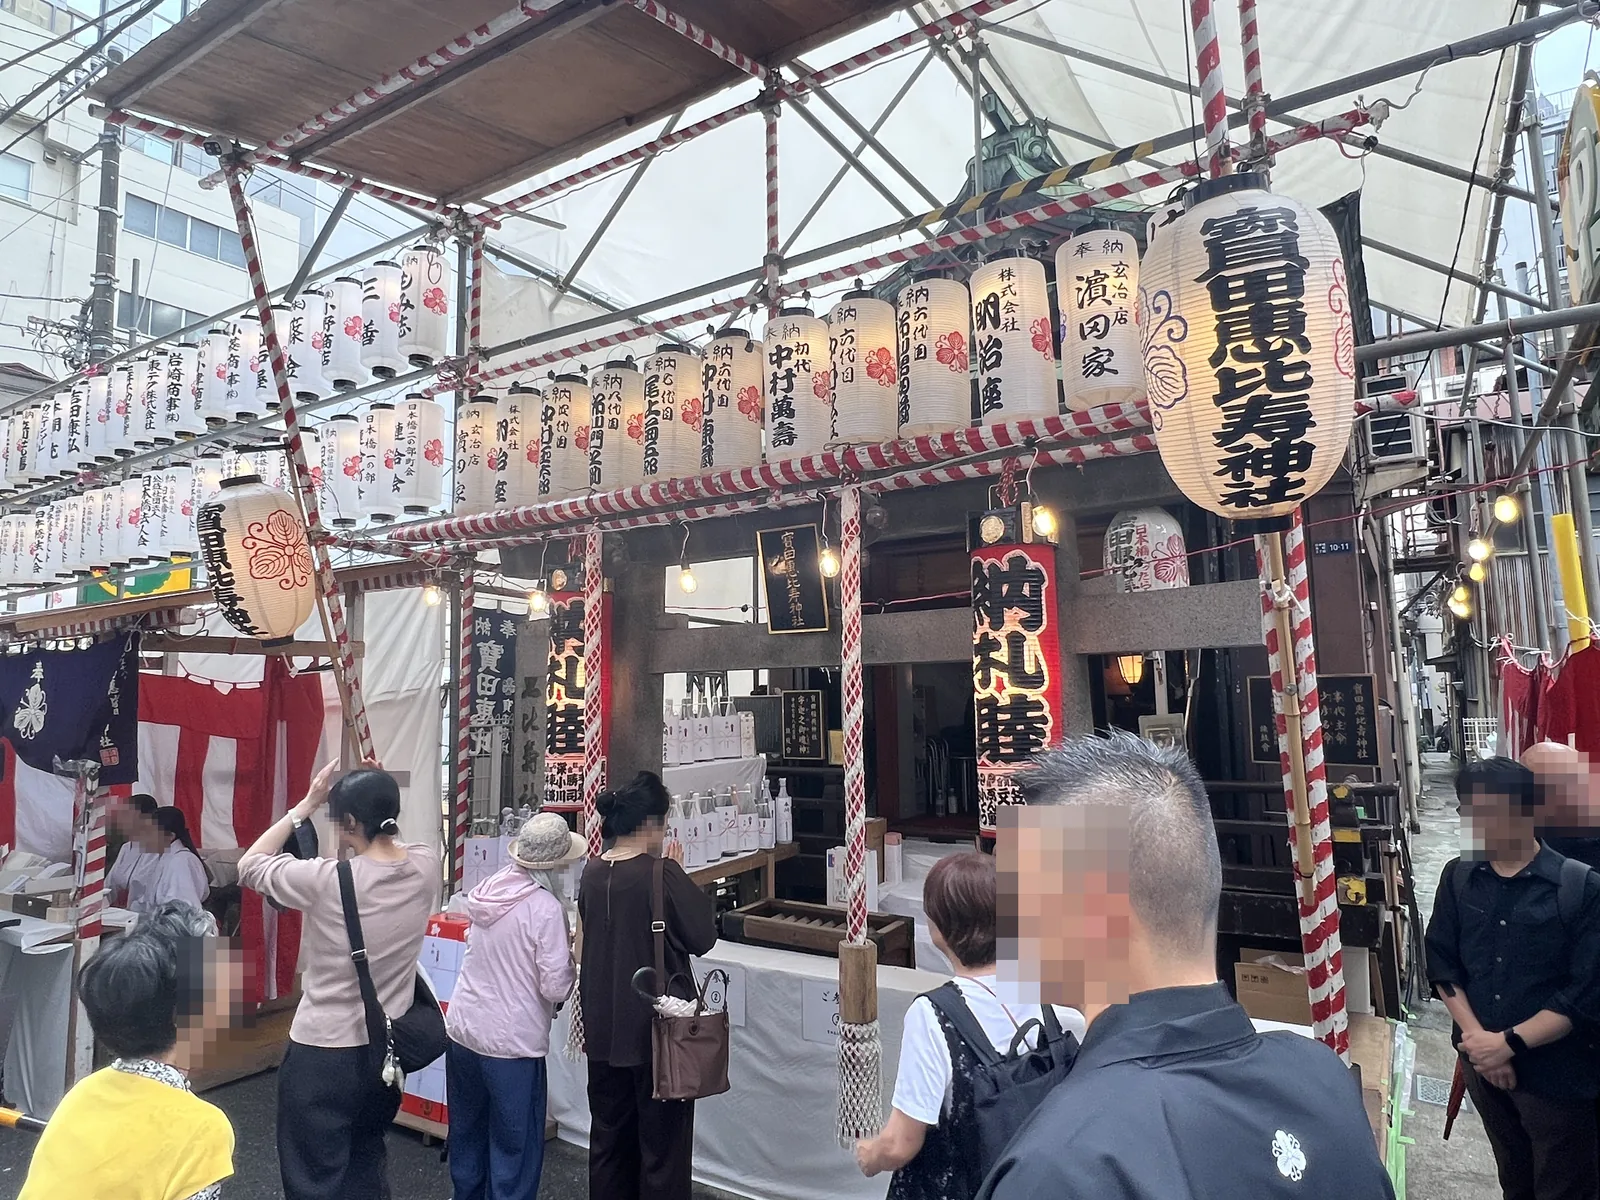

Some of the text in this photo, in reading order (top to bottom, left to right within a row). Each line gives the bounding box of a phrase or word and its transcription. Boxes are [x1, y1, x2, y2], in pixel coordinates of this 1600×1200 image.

[1073, 239, 1124, 258] 奉納
[997, 266, 1020, 333] 株式会社
[1111, 260, 1130, 327] 玄冶店
[765, 324, 800, 345] 奉納
[913, 306, 928, 362] 六代目
[1074, 269, 1119, 379] 濱田家
[793, 341, 811, 373] 初代
[839, 328, 855, 383] 六代目
[975, 291, 1004, 418] 明治座
[717, 362, 731, 407] 六代目
[365, 414, 377, 484] 日本橋一の部
[405, 403, 418, 476] 日本橋二の部町会
[468, 424, 483, 466] 玄冶店
[507, 404, 520, 450] 株式会社
